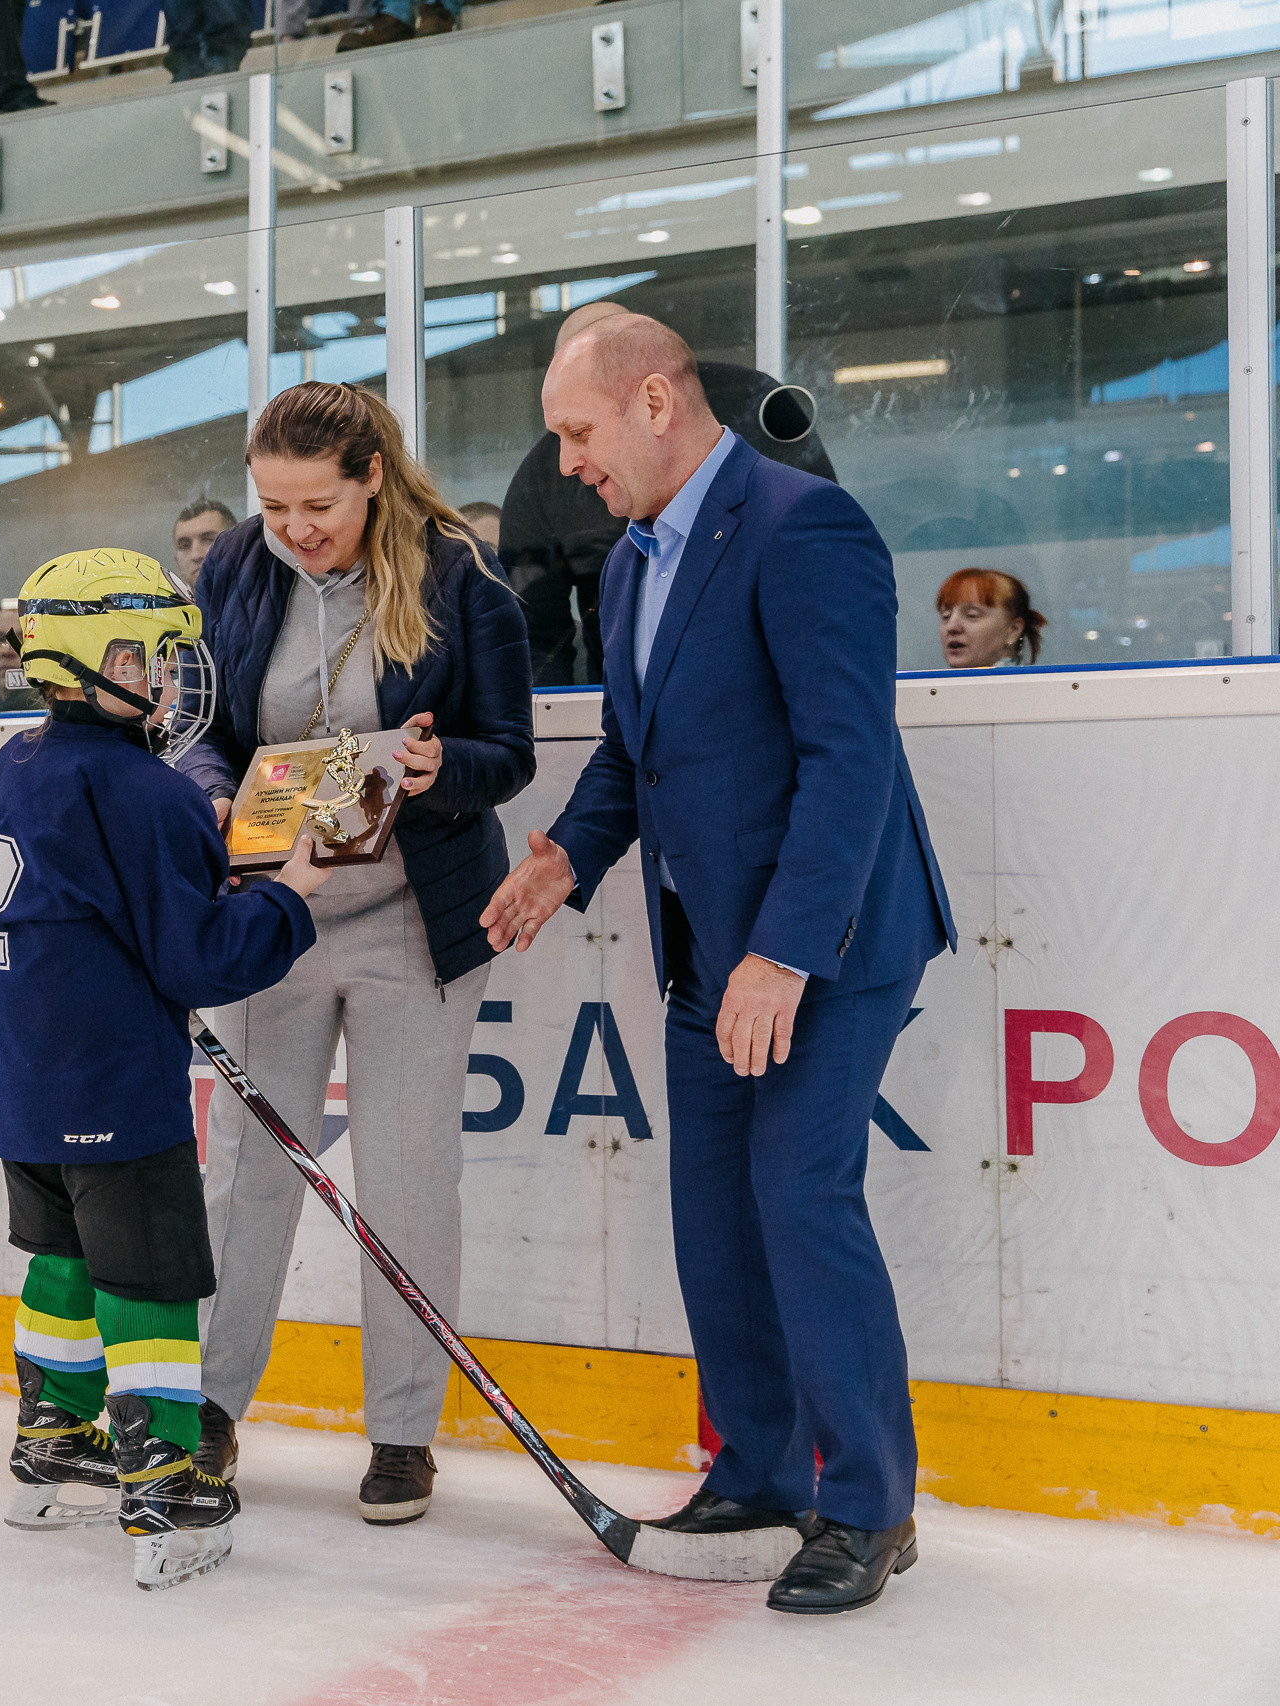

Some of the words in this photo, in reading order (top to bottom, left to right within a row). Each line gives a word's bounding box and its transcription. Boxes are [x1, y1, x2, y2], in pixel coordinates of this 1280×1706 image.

[156, 658, 164, 686] CCM
[255, 787, 283, 797] ЛУЧШИЙ
[285, 785, 308, 793] ИГРОК
[260, 795, 295, 803] КОМАНДЫ
[248, 820, 270, 828] IGORA
[271, 818, 287, 826] CUP
[1004, 1008, 1280, 1167] РО
[63, 1132, 114, 1144] CCM
[83, 1461, 115, 1472] BAUER
